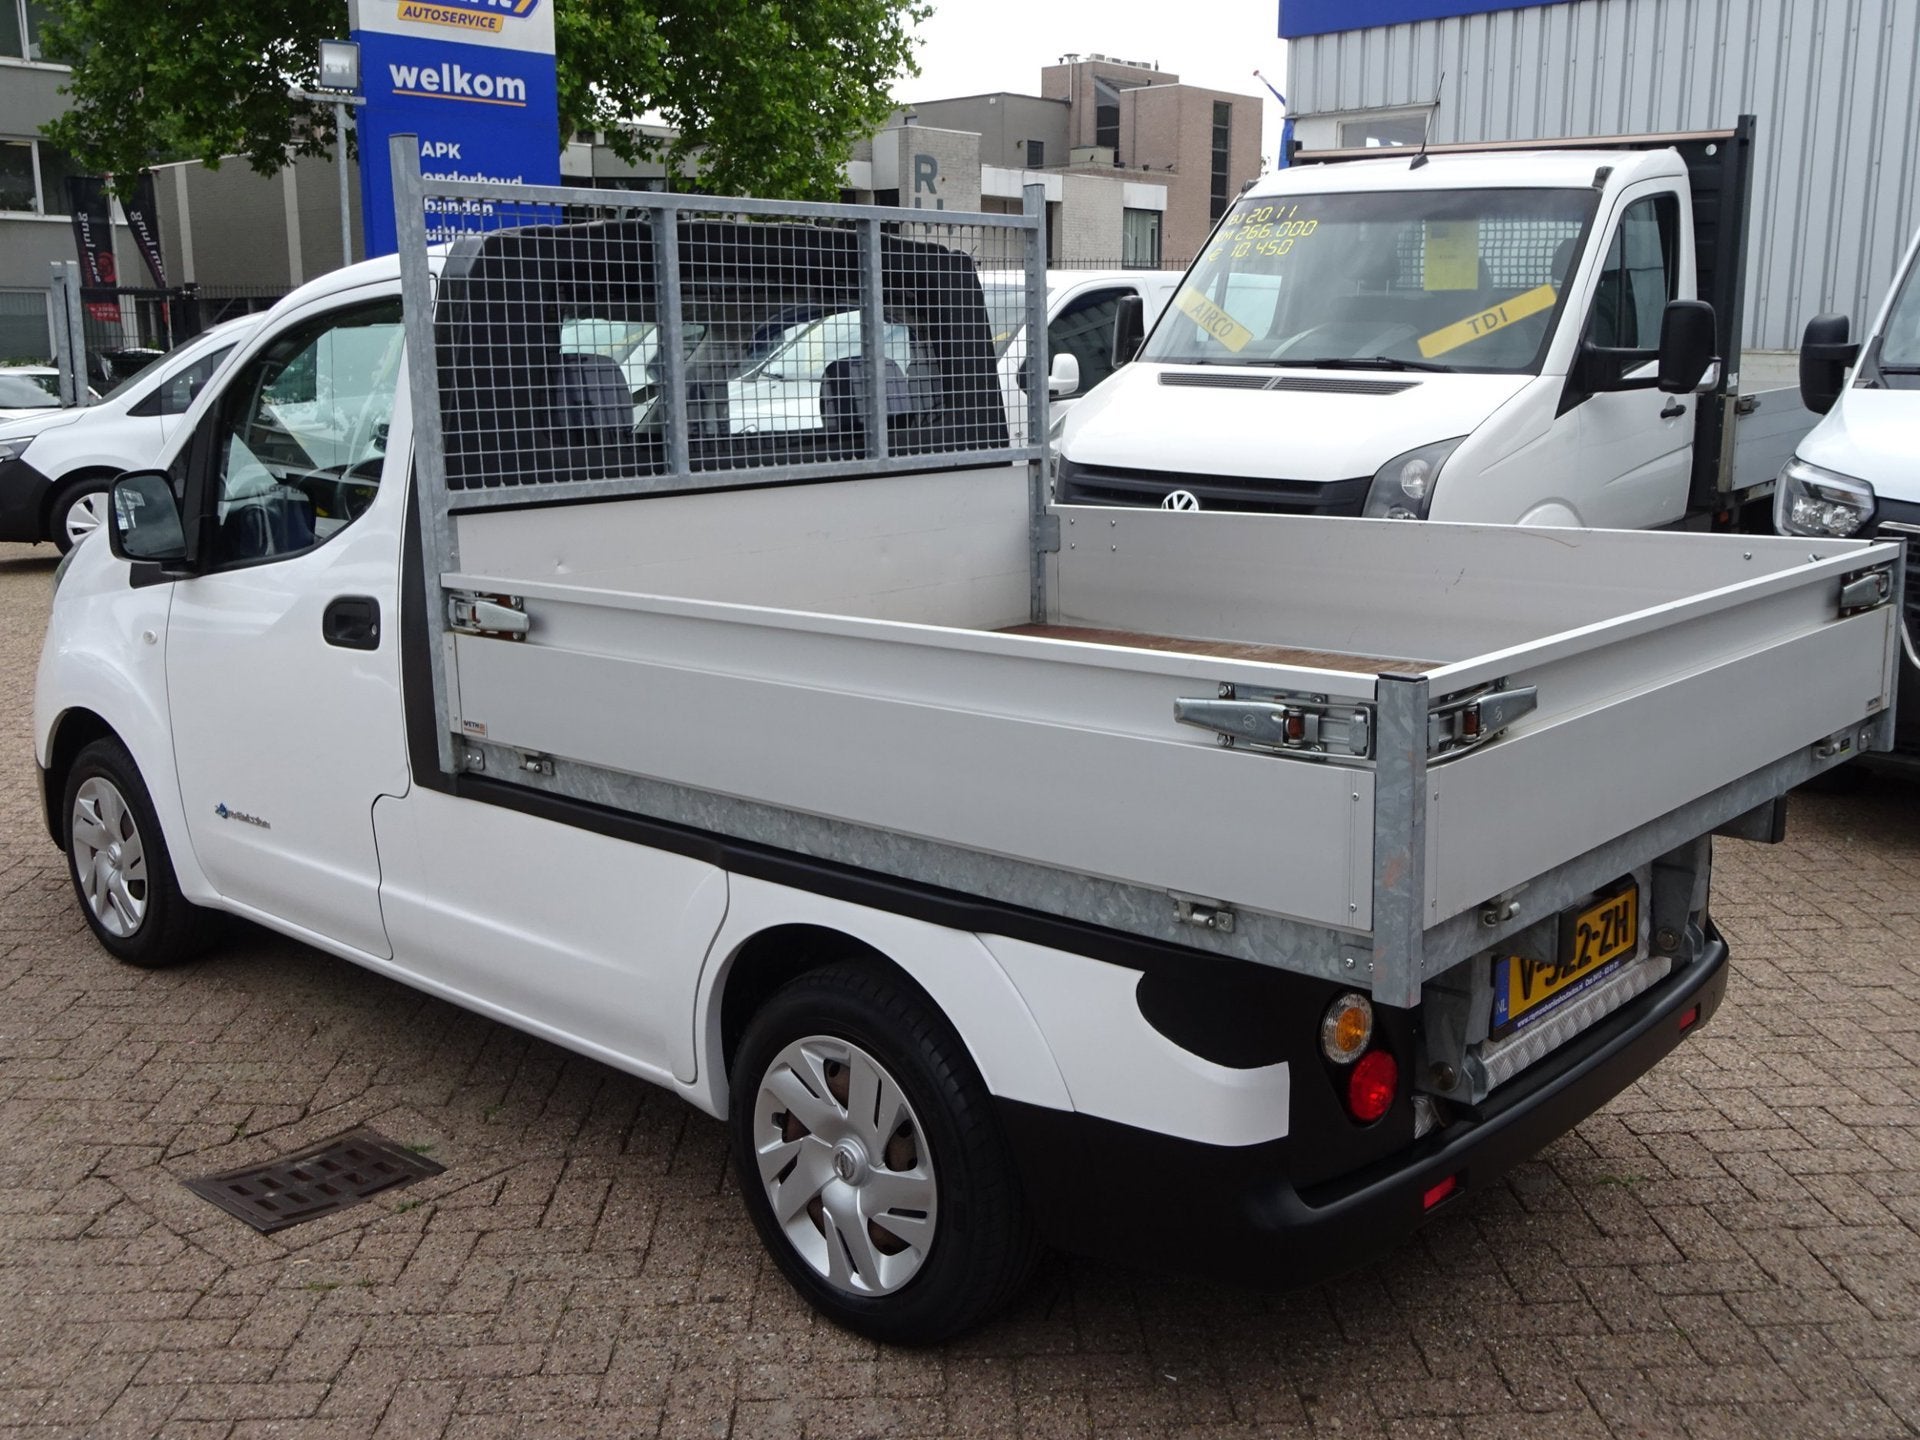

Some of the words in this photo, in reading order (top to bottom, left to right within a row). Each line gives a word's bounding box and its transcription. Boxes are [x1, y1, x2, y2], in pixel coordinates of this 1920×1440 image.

[403, 6, 496, 29] AUTOSERVICE
[389, 63, 526, 100] welkom
[421, 141, 461, 160] APK
[424, 197, 493, 216] banden
[1246, 205, 1298, 224] 2011
[1234, 220, 1318, 241] 266.000
[1230, 239, 1294, 258] 10.450
[1189, 301, 1234, 337] AIRCO
[1466, 307, 1508, 335] TDI
[1496, 998, 1508, 1013] NL
